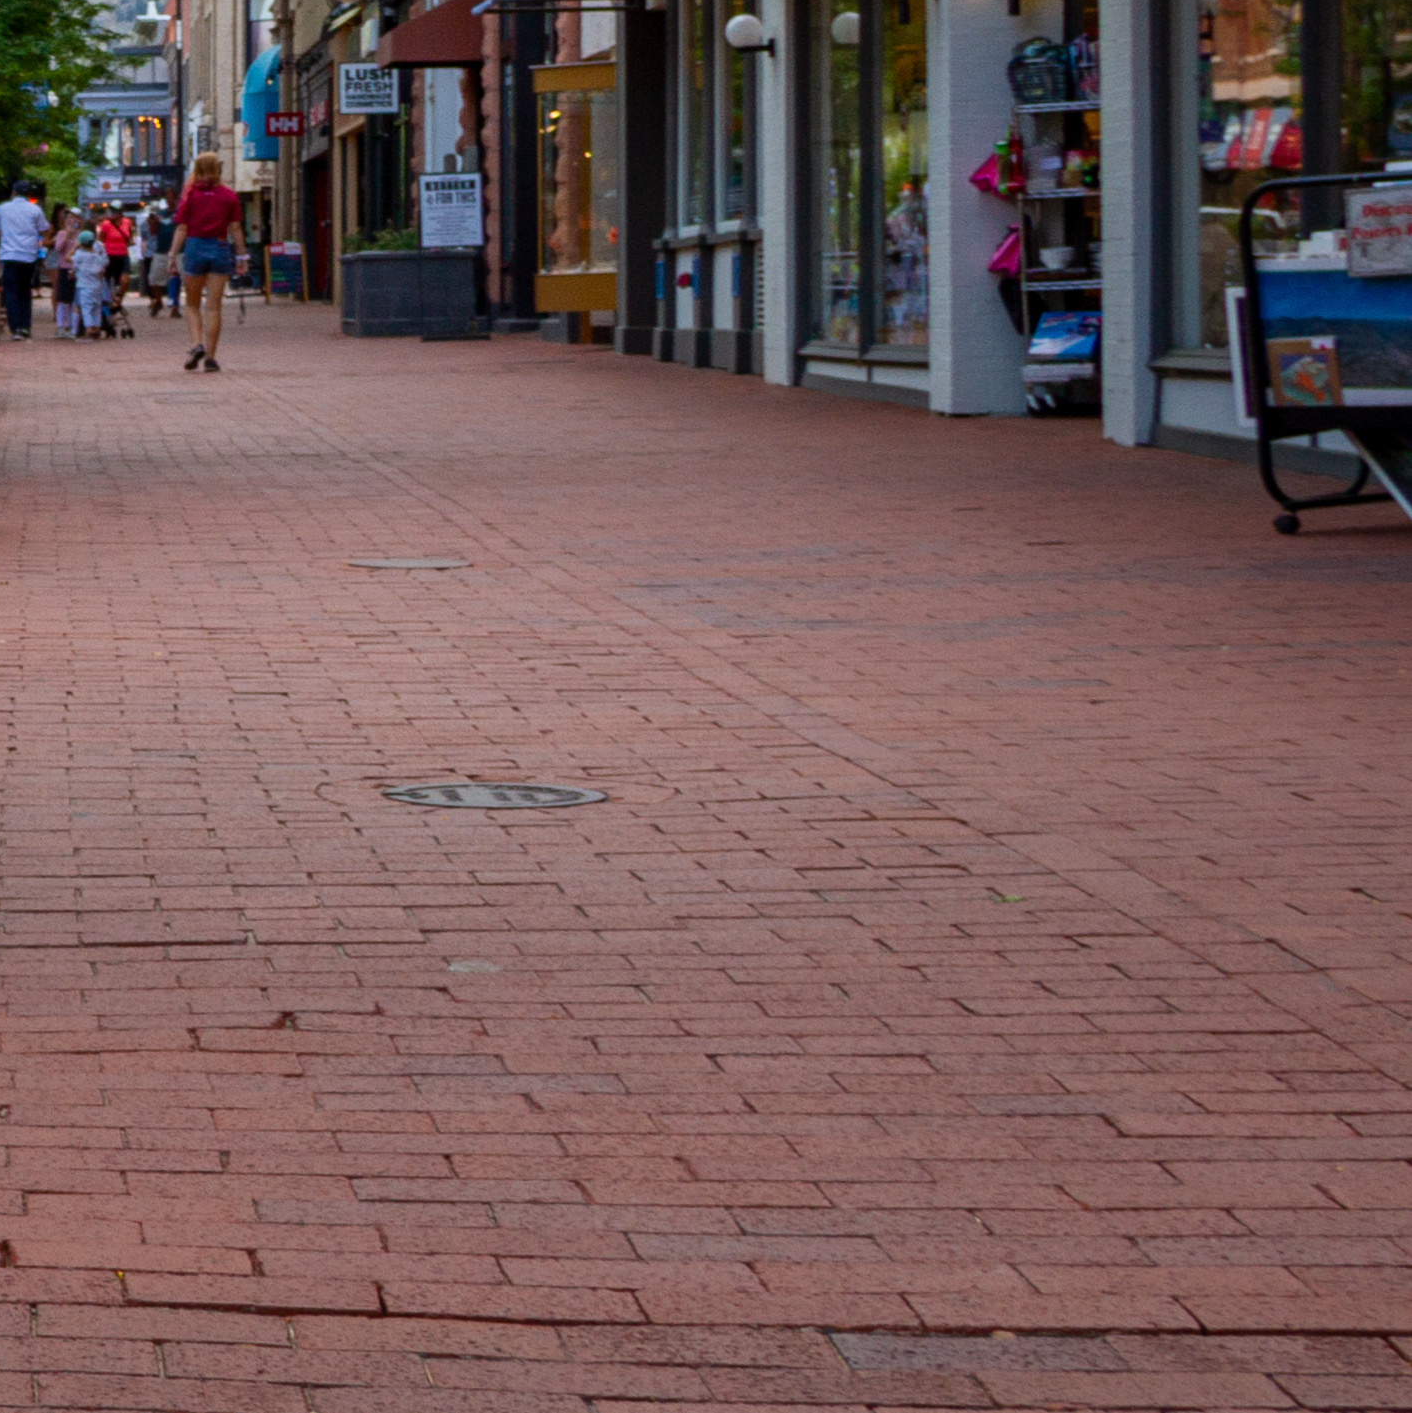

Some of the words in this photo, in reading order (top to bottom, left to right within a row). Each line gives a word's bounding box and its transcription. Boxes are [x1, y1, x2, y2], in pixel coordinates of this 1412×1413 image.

[345, 68, 392, 81] LUSH
[345, 82, 392, 93] FRESH
[269, 115, 299, 133] HH
